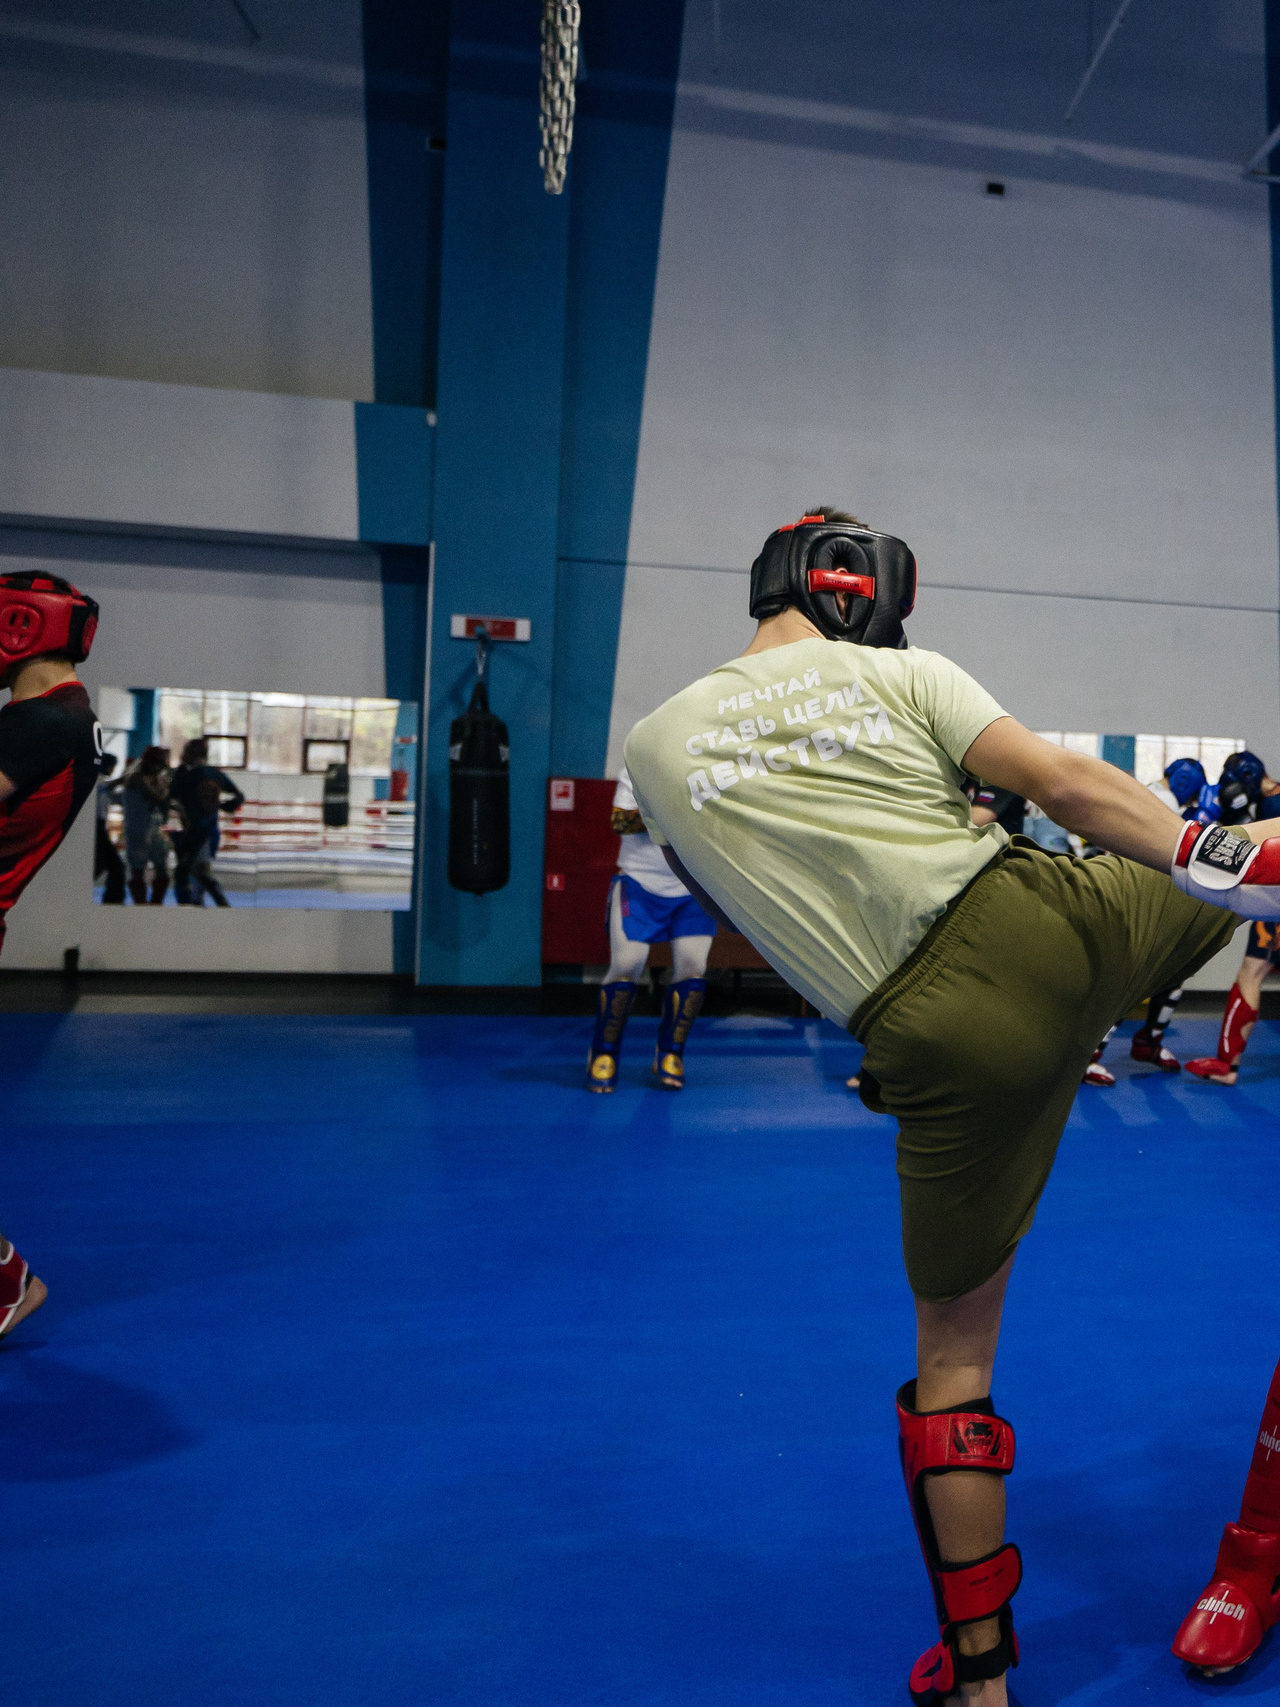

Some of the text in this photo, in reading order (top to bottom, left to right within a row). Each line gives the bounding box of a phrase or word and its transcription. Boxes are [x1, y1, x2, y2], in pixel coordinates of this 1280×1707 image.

[685, 681, 865, 756] СТАВЬ ЦЕЛИ
[718, 667, 821, 715] МЕЧТАЙ
[685, 704, 896, 811] ДЕЙСТВУЙ
[1196, 1596, 1246, 1621] clinch
